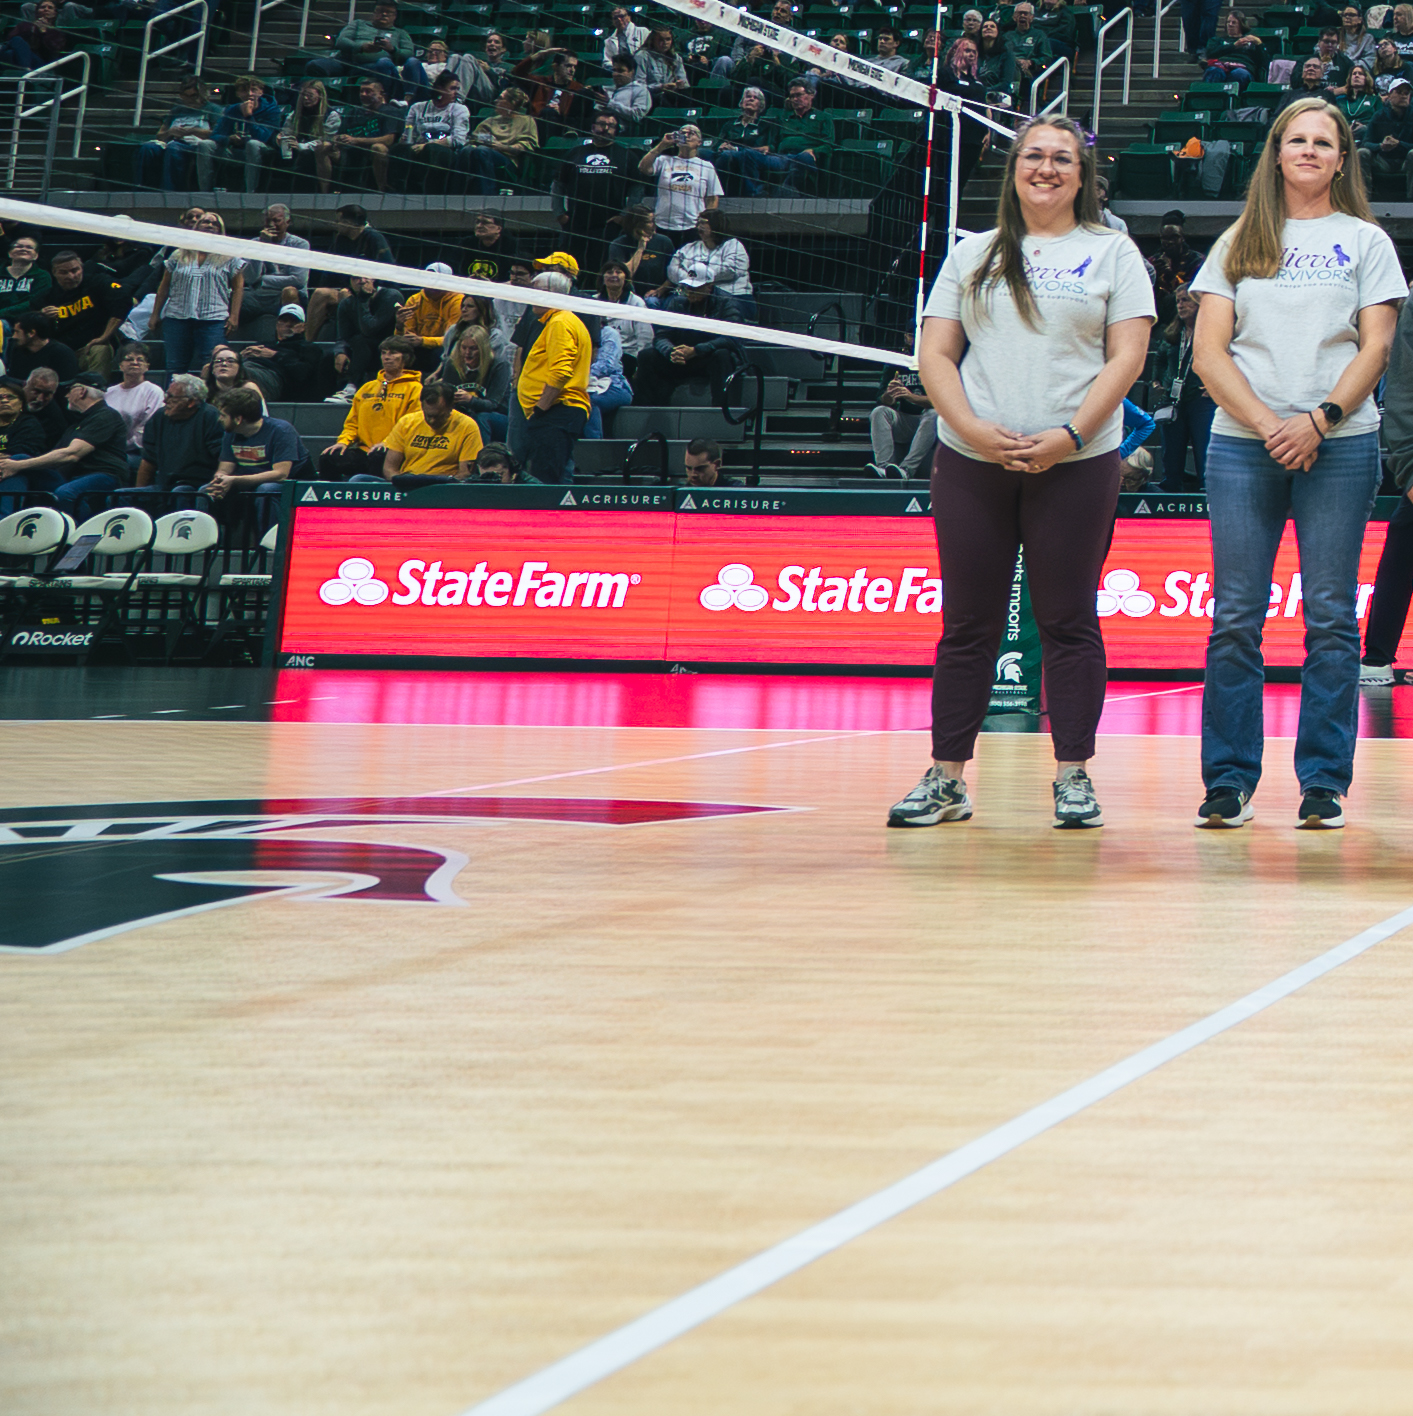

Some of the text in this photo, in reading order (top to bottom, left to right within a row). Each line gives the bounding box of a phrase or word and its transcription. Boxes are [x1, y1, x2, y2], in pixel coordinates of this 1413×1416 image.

[58, 295, 94, 319] OWA
[322, 490, 402, 501] ACRISURE
[582, 494, 661, 505] ACRISURE
[701, 498, 780, 510] ACRISURE
[1007, 583, 1022, 642] imports
[27, 631, 94, 646] Rocket
